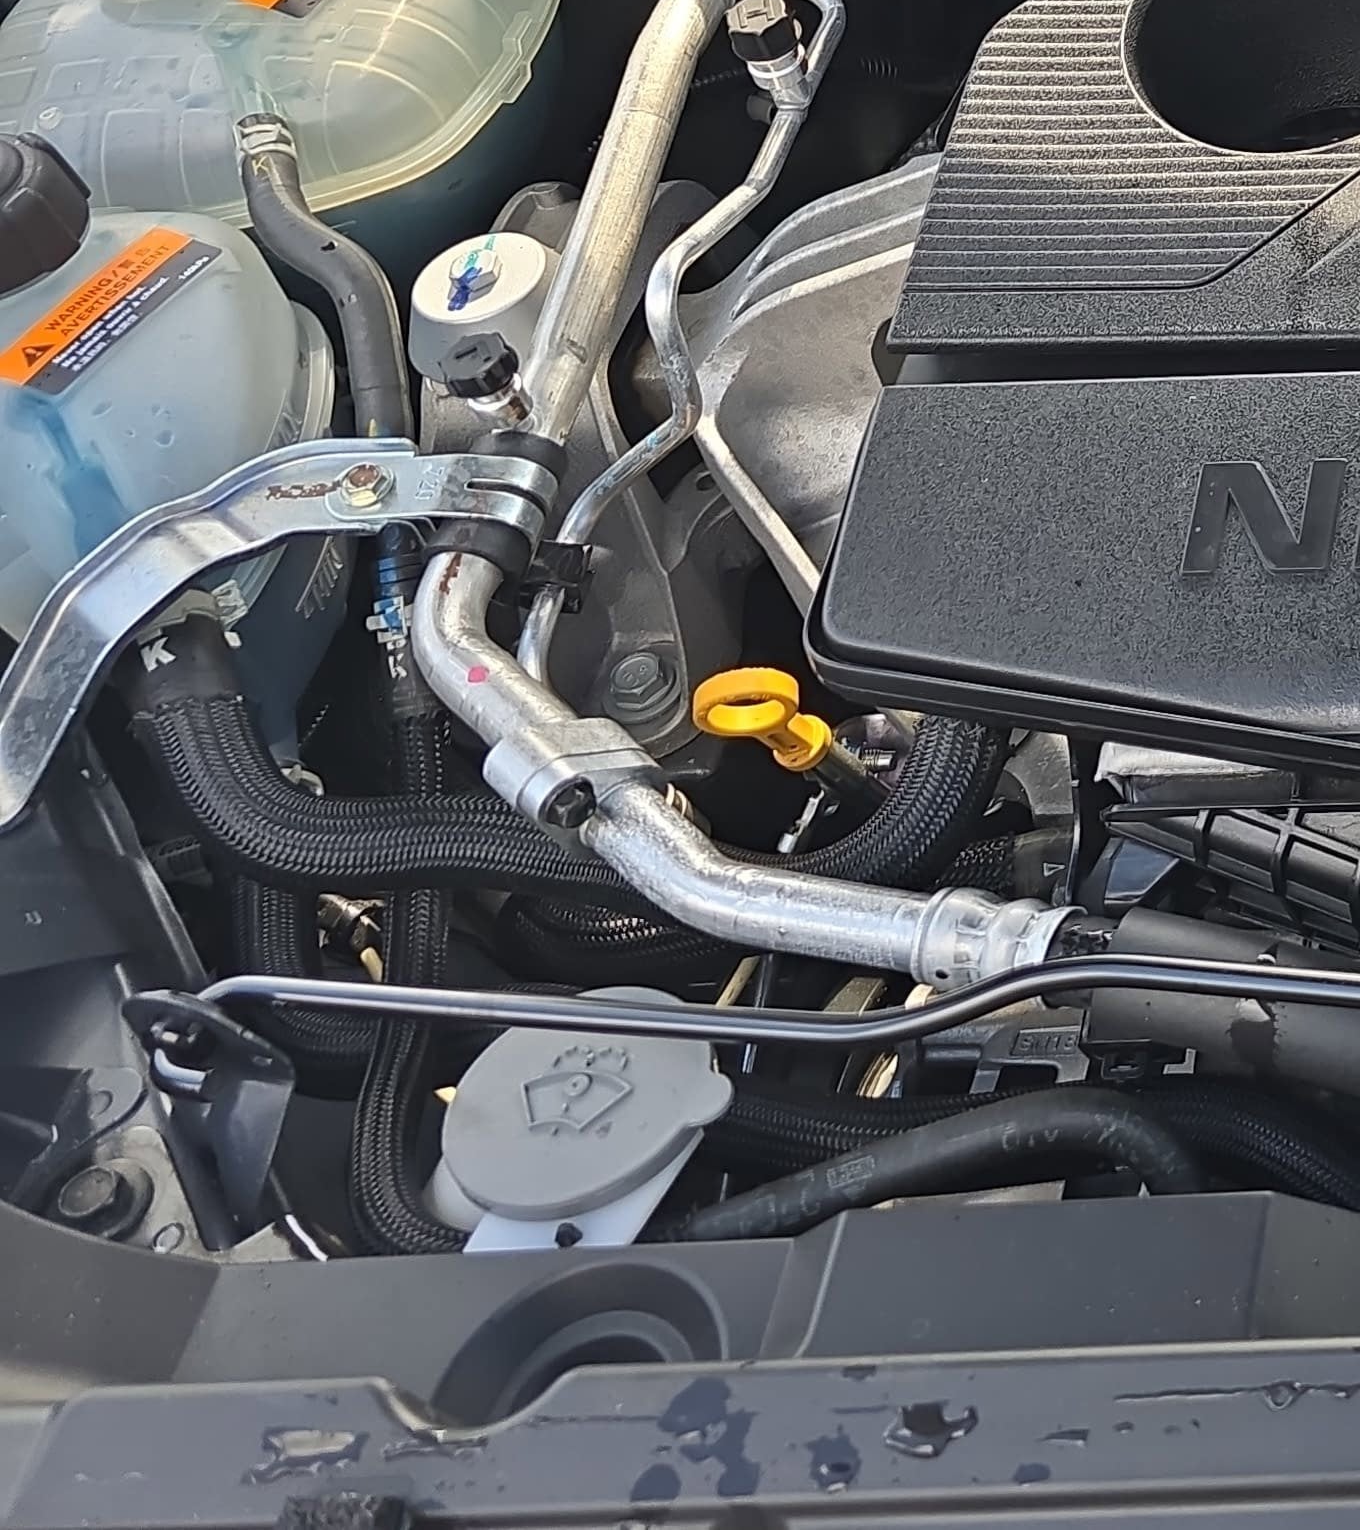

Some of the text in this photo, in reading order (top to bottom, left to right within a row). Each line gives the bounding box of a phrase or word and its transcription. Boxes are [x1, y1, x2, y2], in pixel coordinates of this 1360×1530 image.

[44, 275, 113, 332] WARNING
[60, 245, 171, 337] AVERTISSEMENT
[141, 636, 177, 673] K
